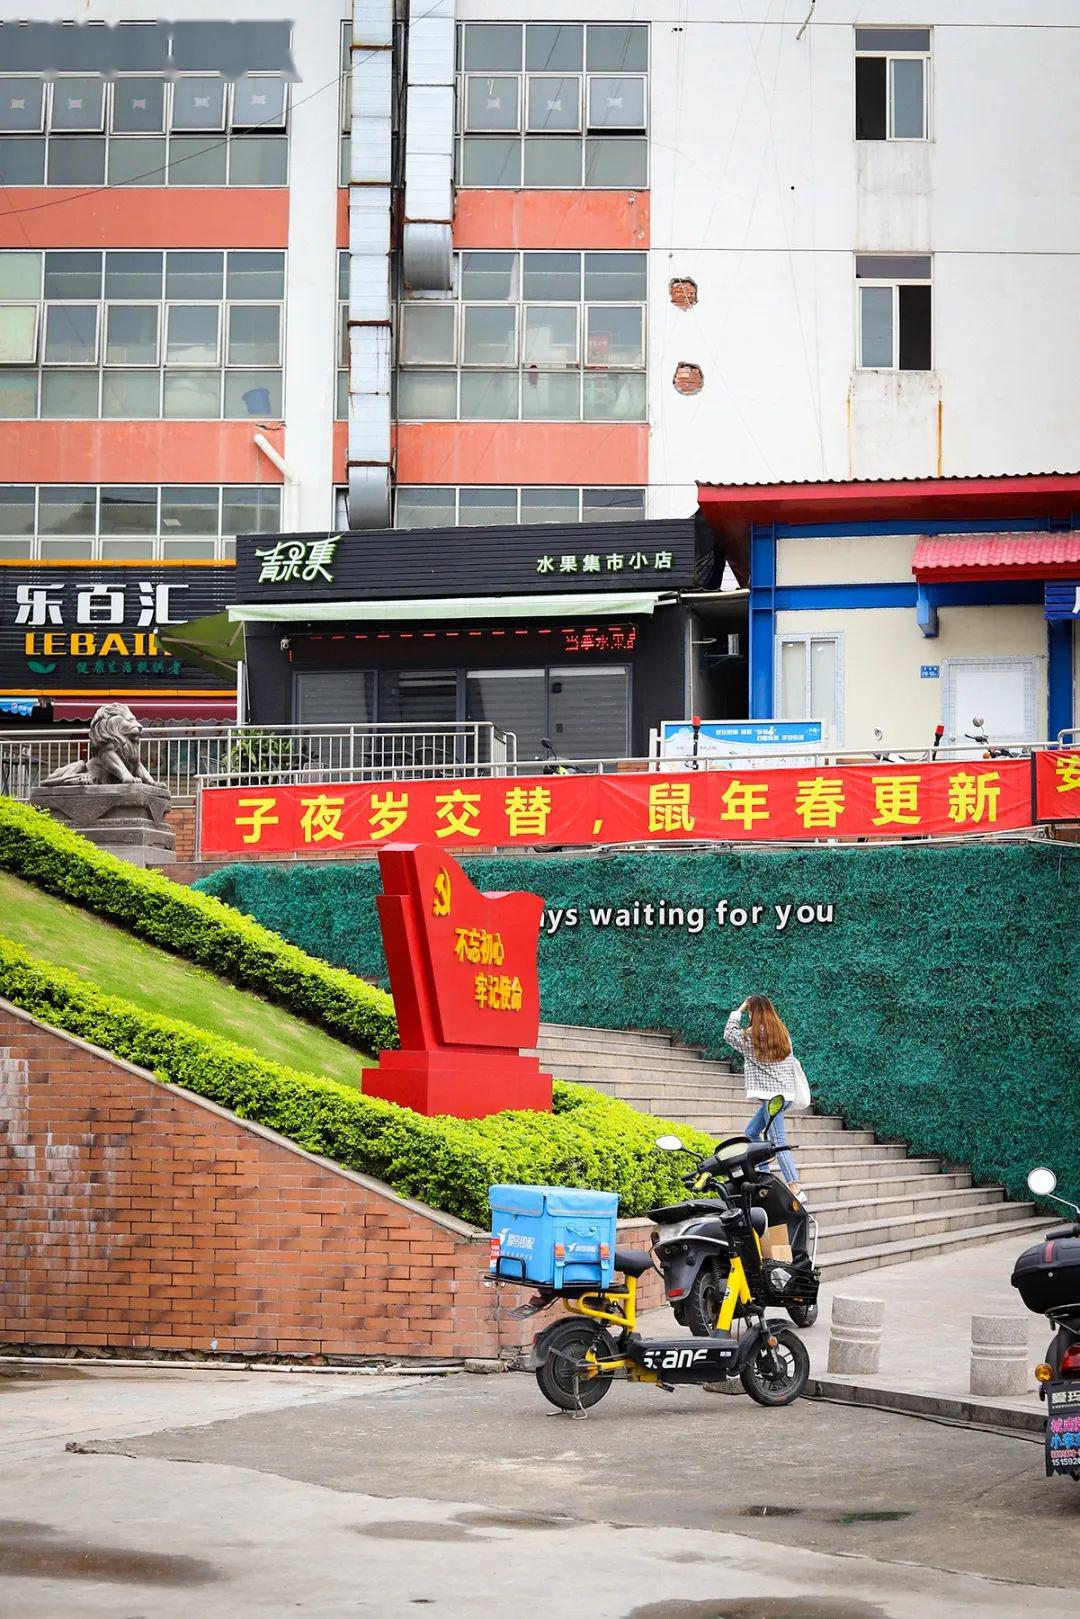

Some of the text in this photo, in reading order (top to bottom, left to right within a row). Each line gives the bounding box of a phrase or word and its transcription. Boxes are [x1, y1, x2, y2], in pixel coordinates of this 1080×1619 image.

[536, 551, 673, 573] 水果集市小店
[14, 581, 190, 627] 乐百汇
[589, 900, 705, 933] waiting
[715, 899, 763, 927] for
[775, 902, 834, 931] you
[454, 927, 505, 966] 不忘初心
[474, 971, 523, 1012] 牢记使命
